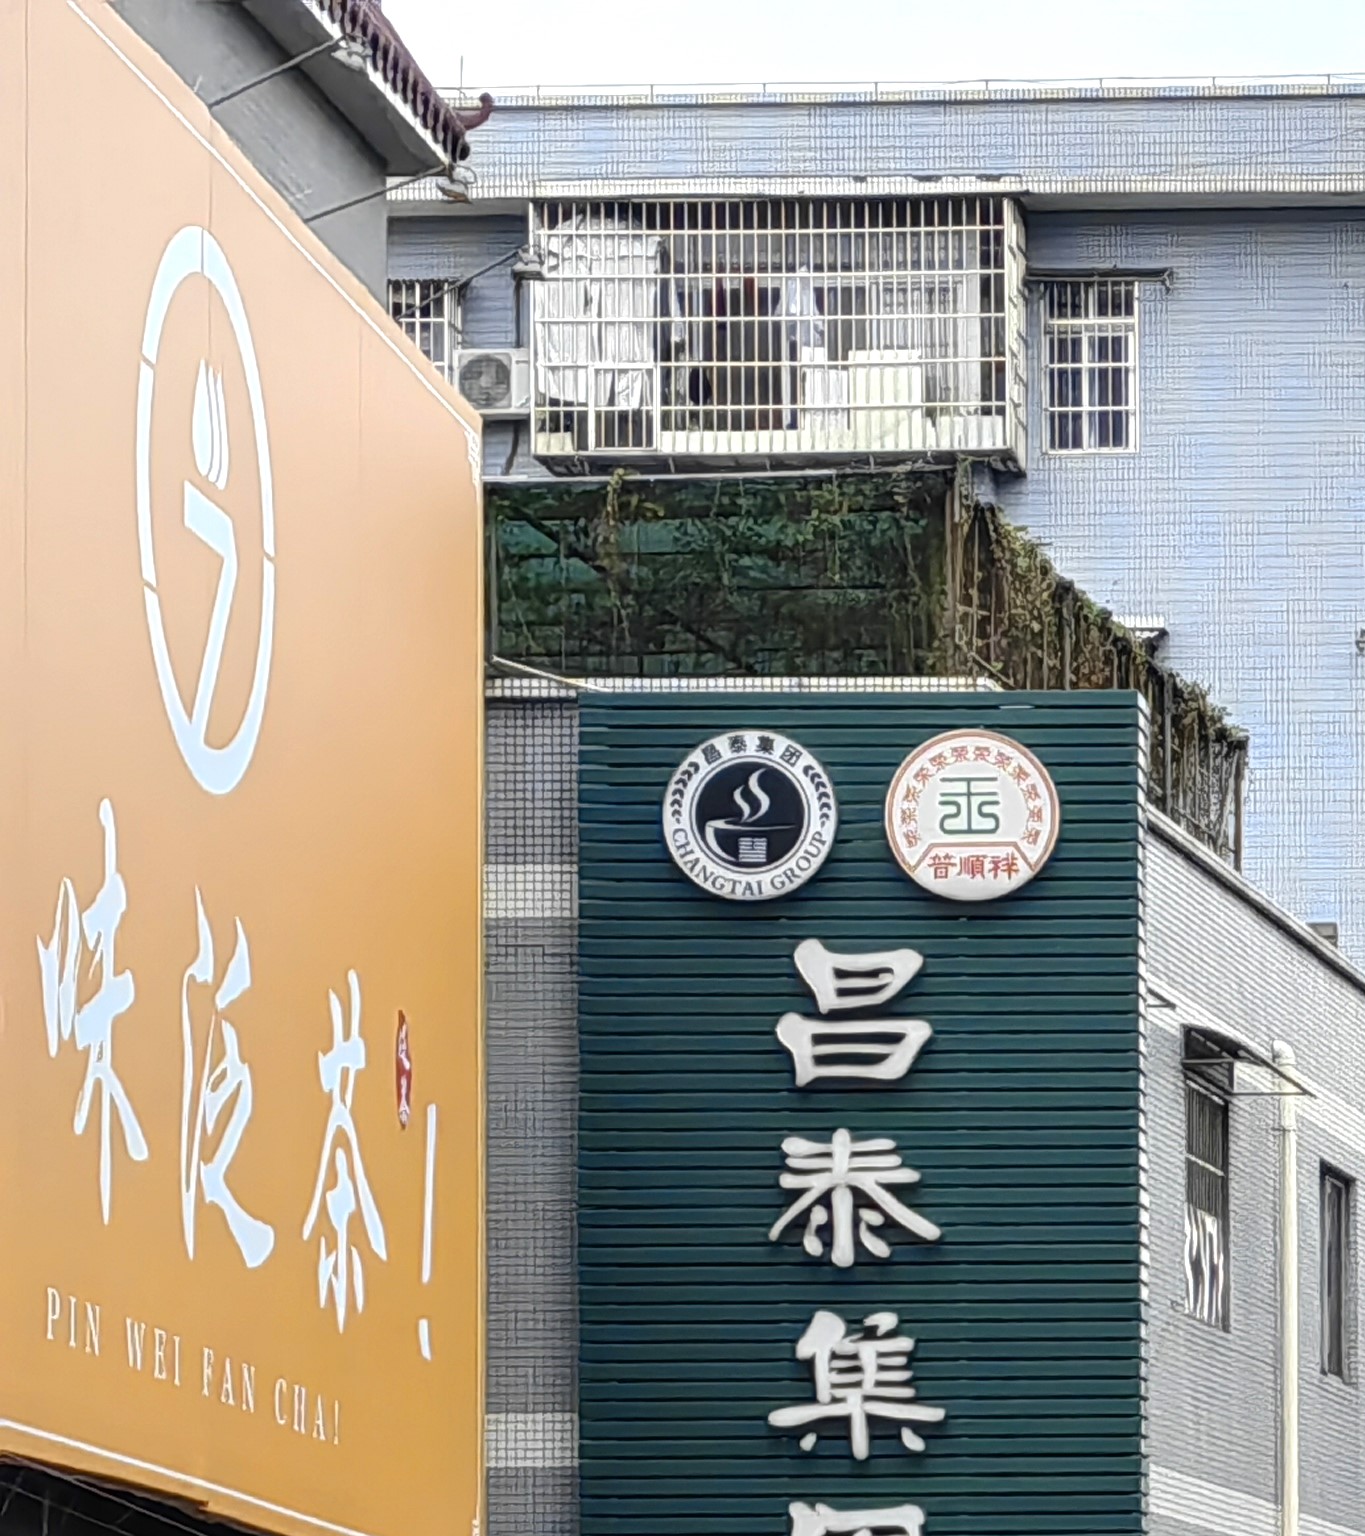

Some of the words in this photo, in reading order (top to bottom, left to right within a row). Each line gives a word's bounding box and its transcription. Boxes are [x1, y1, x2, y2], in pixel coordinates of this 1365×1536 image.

[672, 828, 764, 896] CHANGTAI
[769, 830, 828, 891] GROUP
[46, 1286, 101, 1357] PIN
[125, 1316, 182, 1387] WEI
[201, 1345, 256, 1414] FAN
[273, 1377, 340, 1446] CHA!
